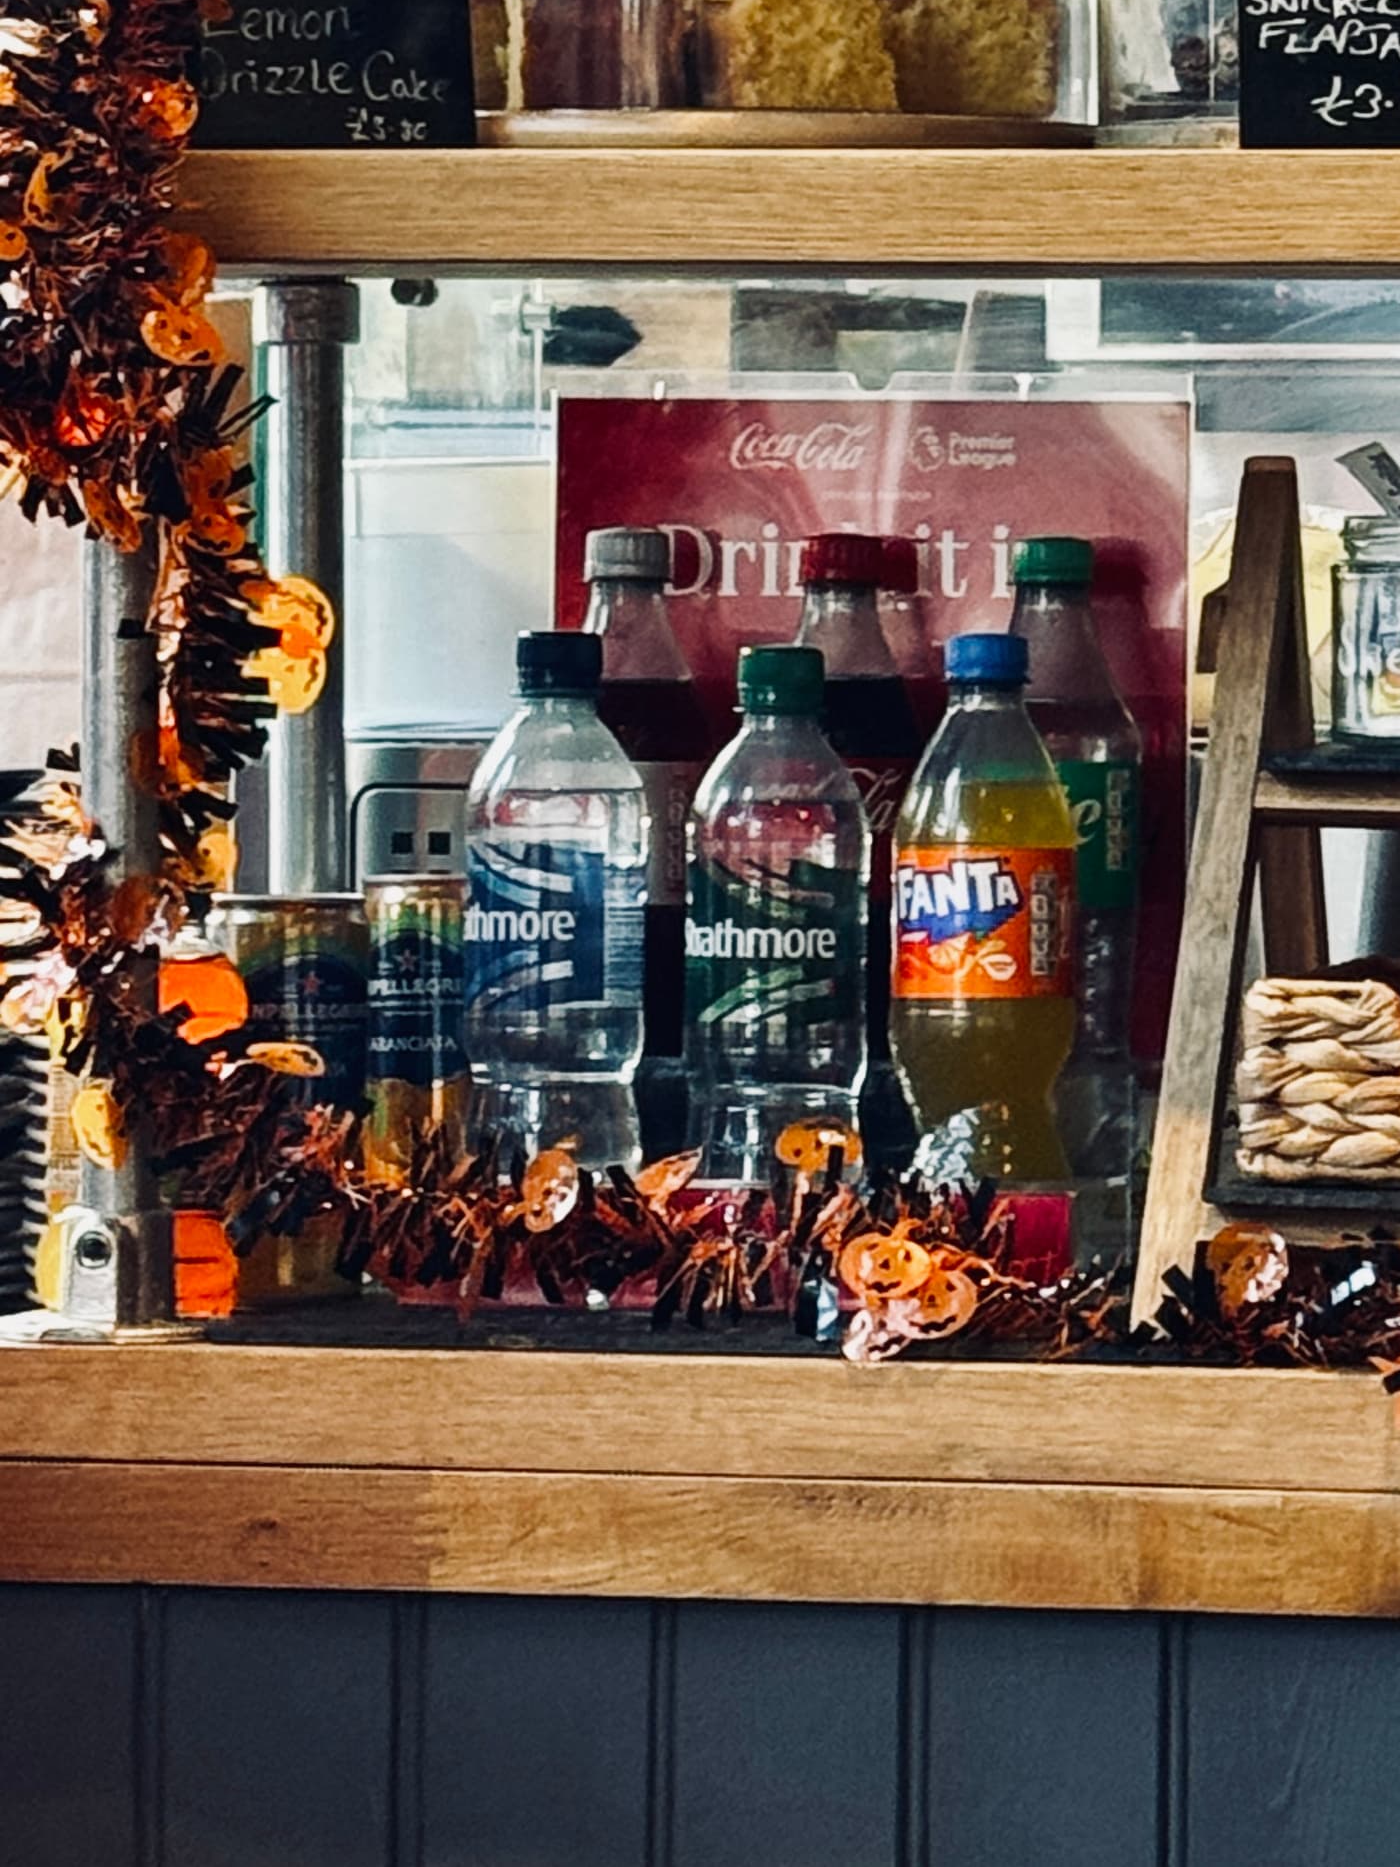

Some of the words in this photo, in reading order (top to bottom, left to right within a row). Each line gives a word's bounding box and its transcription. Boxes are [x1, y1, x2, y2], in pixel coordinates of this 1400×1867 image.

[949, 433, 1015, 450] Premier
[913, 524, 968, 600] it
[899, 860, 1019, 921] FANTA
